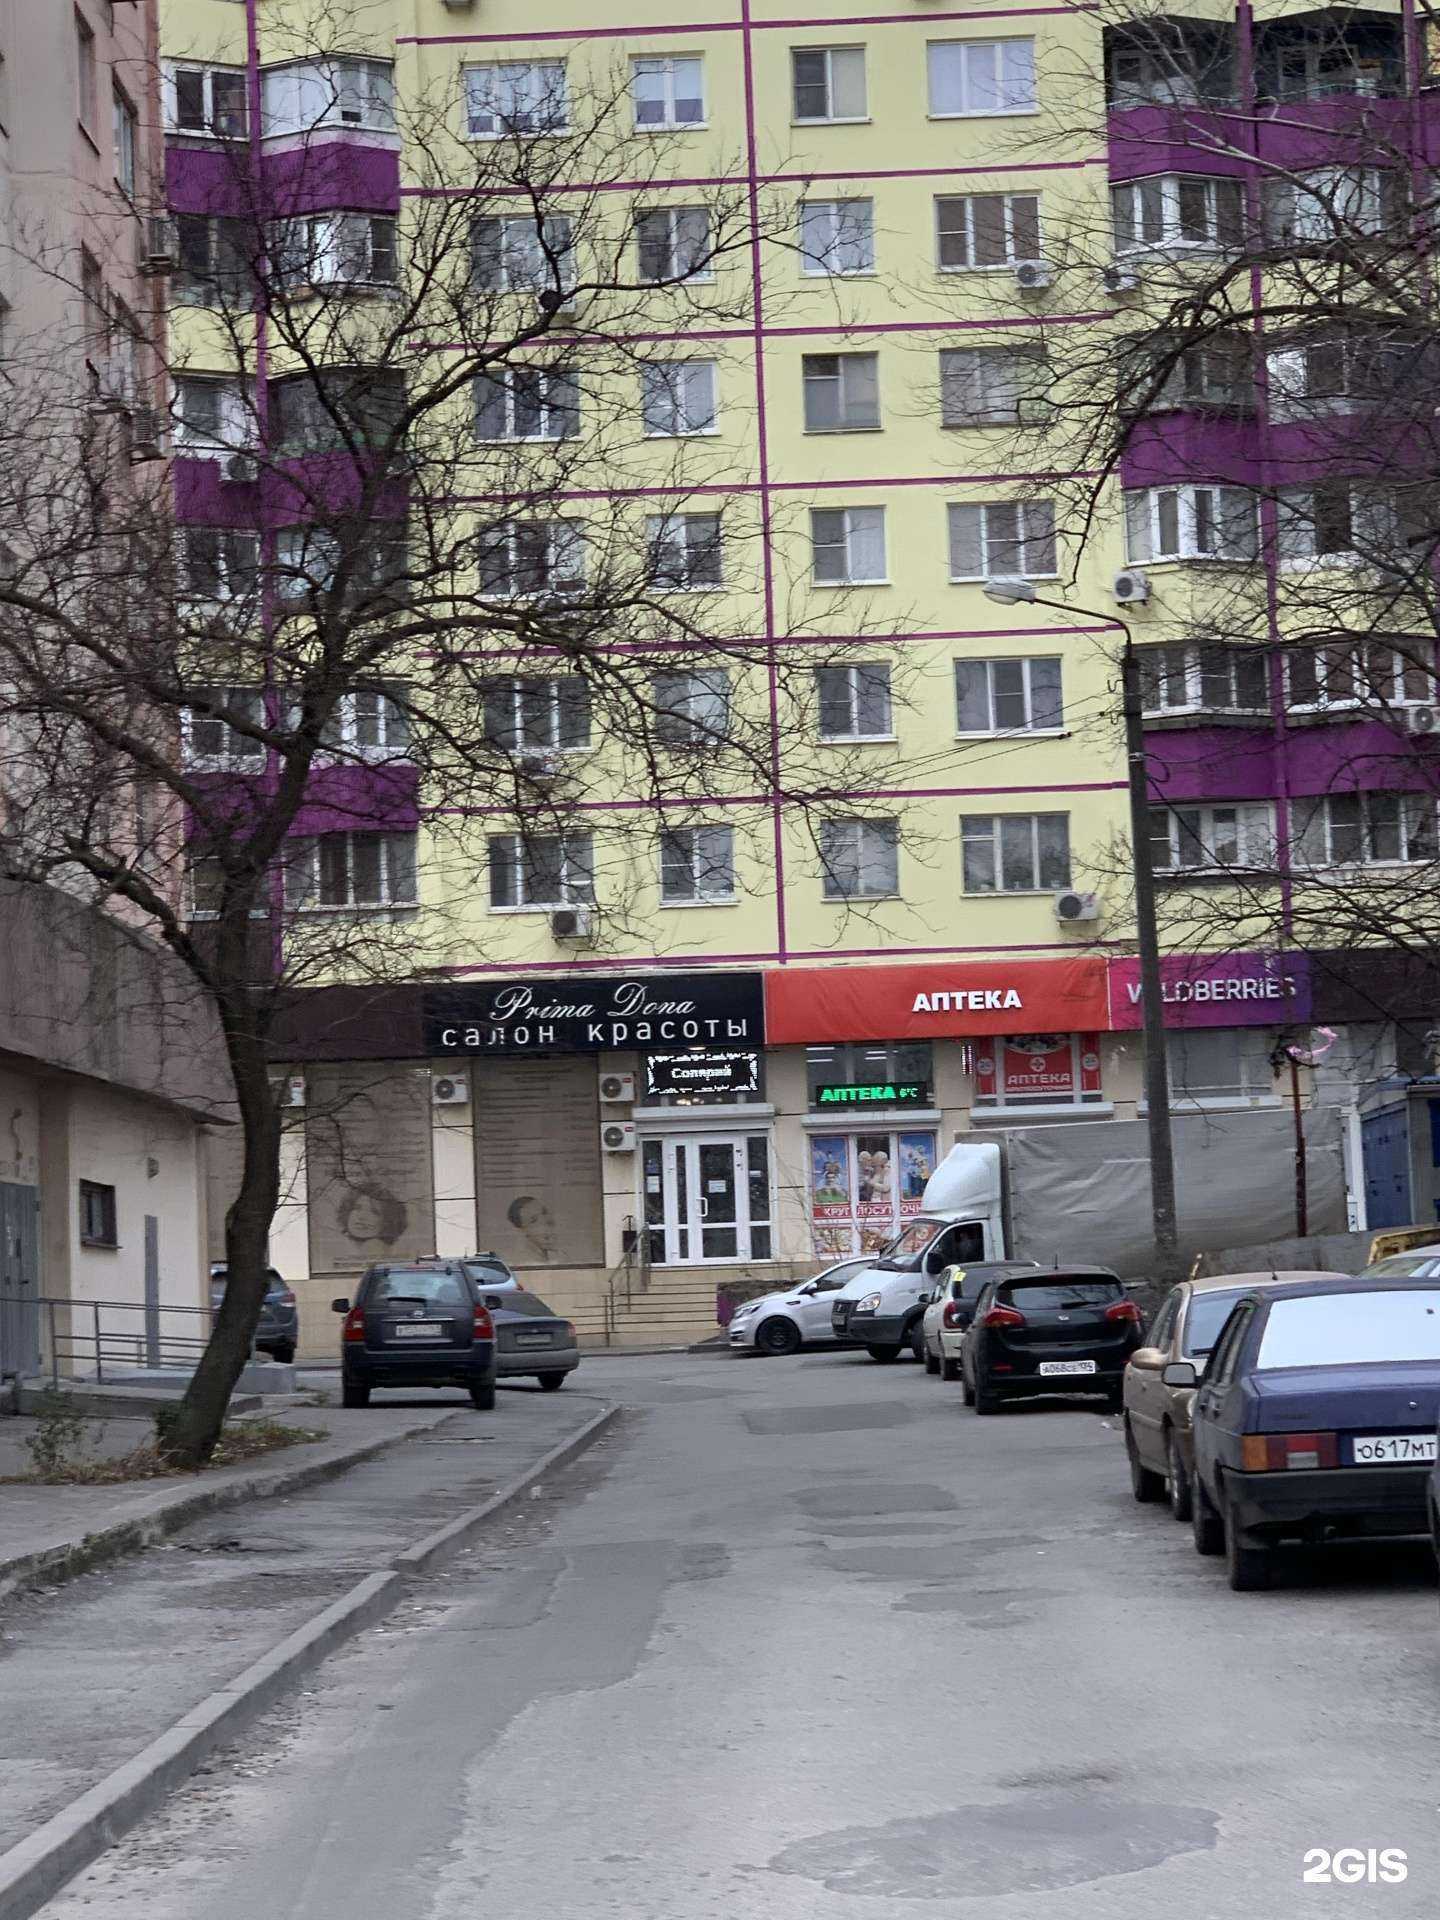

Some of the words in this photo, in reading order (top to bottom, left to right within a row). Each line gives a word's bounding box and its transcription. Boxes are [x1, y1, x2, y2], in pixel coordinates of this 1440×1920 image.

[490, 985, 596, 1021] Prima
[606, 982, 696, 1017] Dona
[911, 989, 1023, 1012] АПТЕКА
[1127, 976, 1296, 1004] WLDBERRIE
[441, 1025, 555, 1047] салон
[587, 1018, 748, 1045] красоты
[1007, 1072, 1072, 1085] АПТЕКА
[820, 1086, 896, 1101] АПТЕКА
